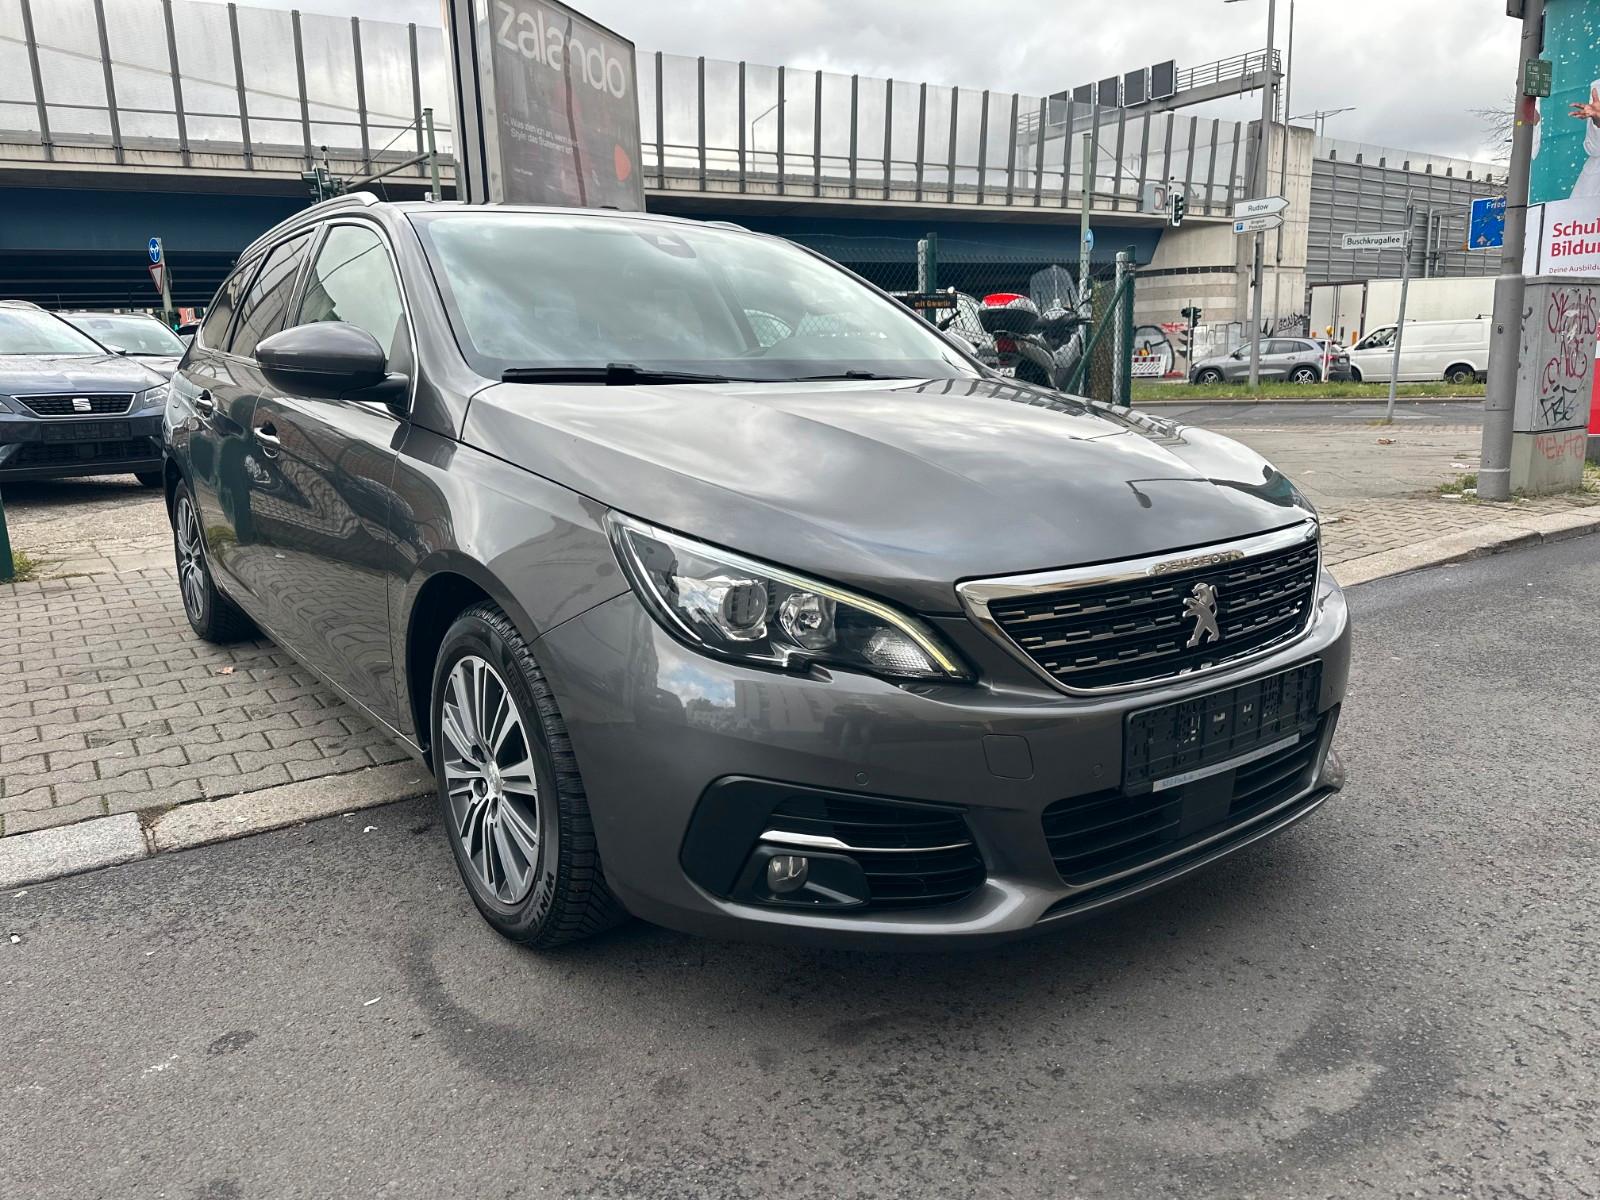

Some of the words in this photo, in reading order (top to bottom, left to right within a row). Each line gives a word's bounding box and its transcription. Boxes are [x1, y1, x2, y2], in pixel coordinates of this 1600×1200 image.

[496, 1, 626, 98] zalando
[1248, 204, 1269, 212] Rudow
[1346, 235, 1401, 245] Buschkrugallee
[1551, 239, 1600, 257] Bildu
[1548, 266, 1568, 274] Deine
[1158, 551, 1232, 572] PEUGEOT
